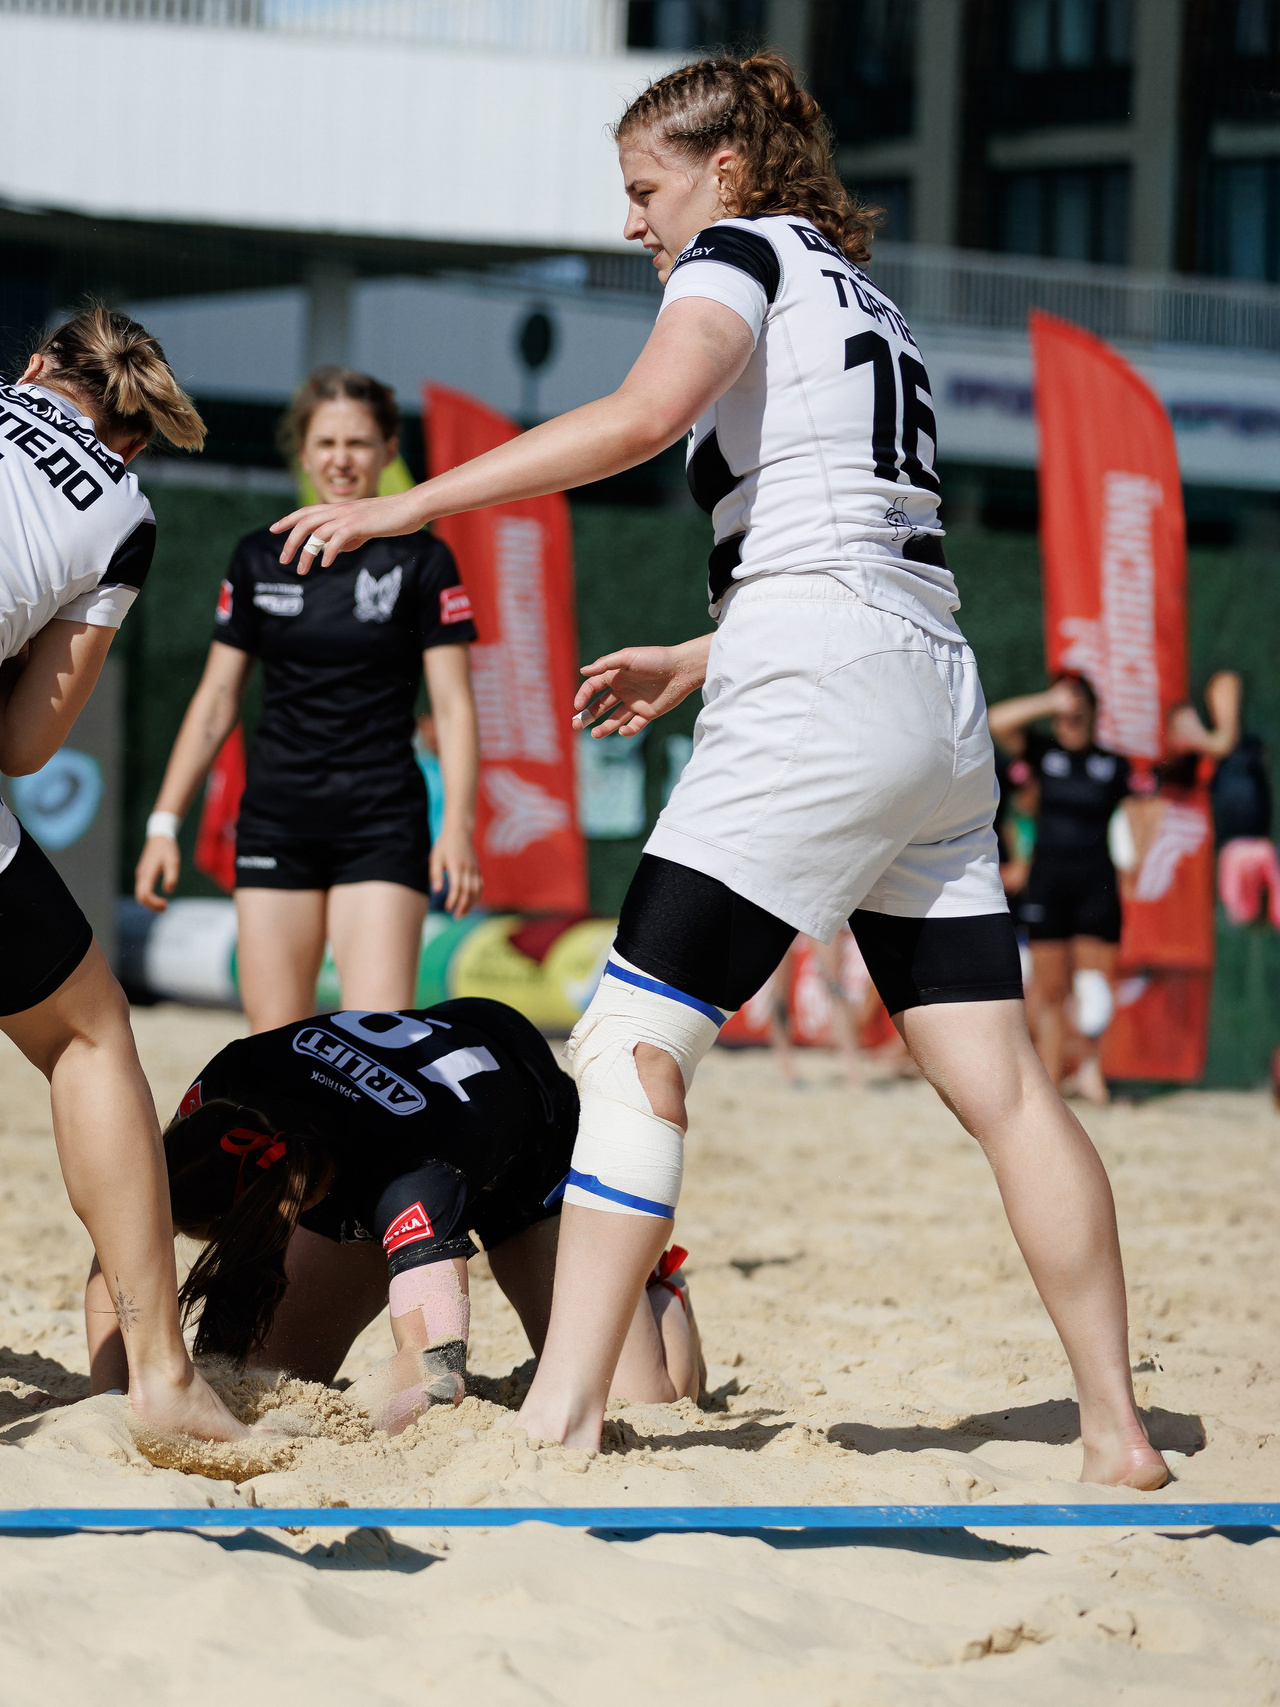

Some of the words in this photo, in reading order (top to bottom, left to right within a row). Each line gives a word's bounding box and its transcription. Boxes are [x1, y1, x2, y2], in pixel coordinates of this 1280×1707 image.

[843, 329, 940, 494] 16
[298, 1030, 421, 1105] ARLIFT
[309, 1070, 353, 1098] PATRICK
